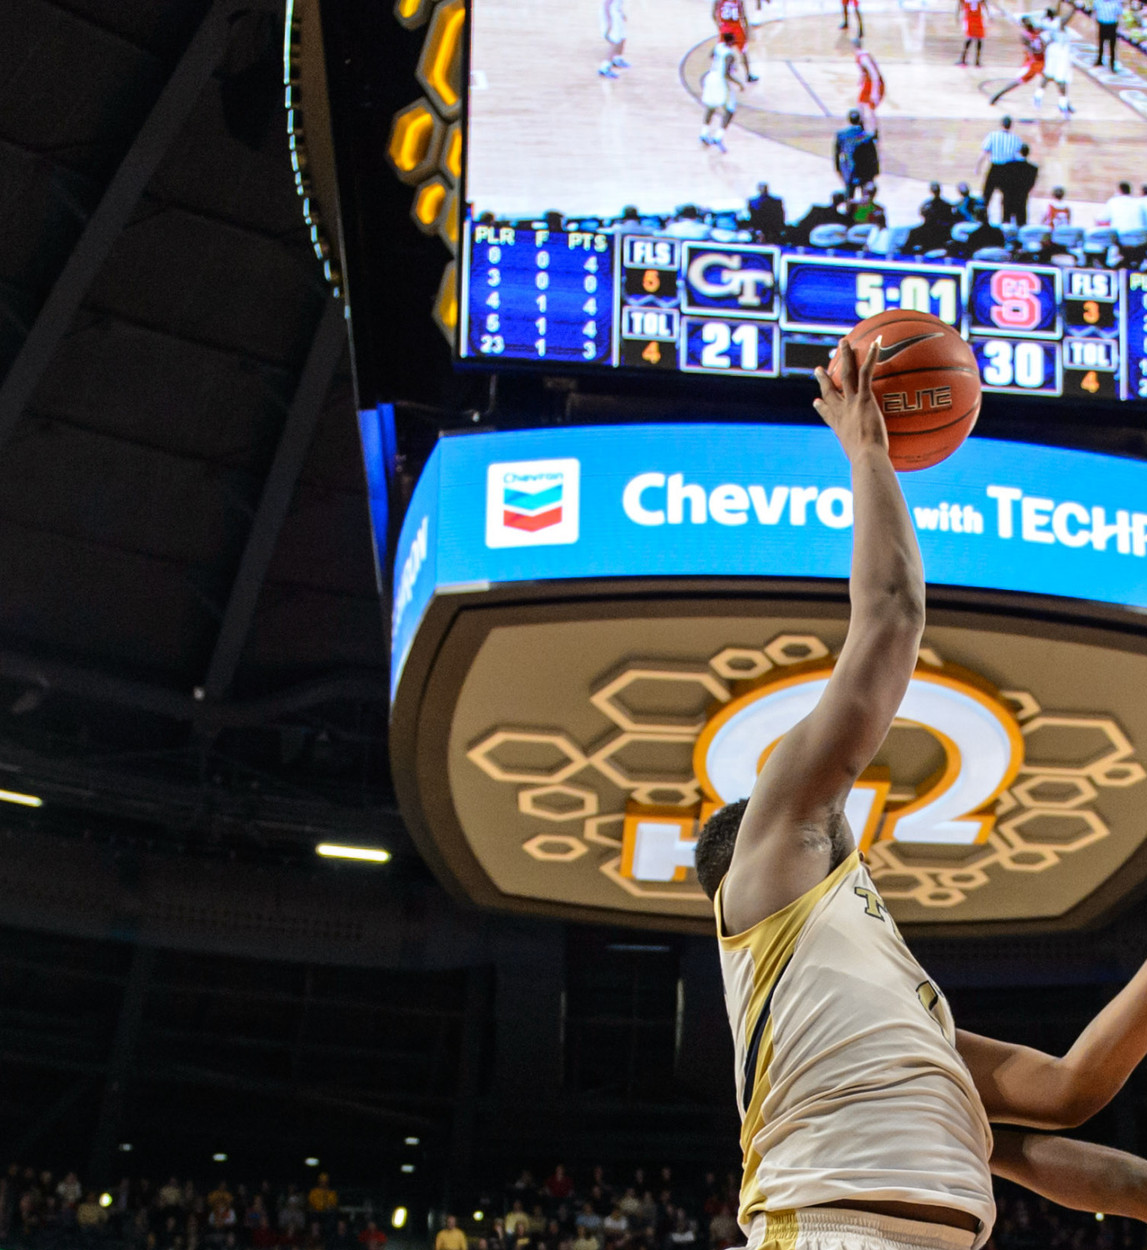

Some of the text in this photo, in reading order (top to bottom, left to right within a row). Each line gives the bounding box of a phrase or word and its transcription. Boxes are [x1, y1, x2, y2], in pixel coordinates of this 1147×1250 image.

[475, 225, 607, 252] PLR F PTS
[536, 251, 549, 269] 0
[583, 256, 599, 274] 4
[633, 241, 671, 266] FLS
[487, 268, 597, 294] 3 0 0
[688, 253, 774, 307] GT
[1071, 273, 1108, 298] FLS
[485, 291, 597, 316] 4 1 4
[855, 273, 957, 325] 5:01
[631, 312, 671, 337] TOL
[1083, 301, 1100, 324] 3
[535, 317, 547, 336] 1
[582, 320, 597, 339] 4
[480, 335, 596, 360] 23 1 3
[642, 341, 661, 365] 4
[702, 322, 759, 370] 21
[1070, 342, 1109, 366] TOL
[983, 341, 1045, 389] 30
[1080, 370, 1099, 393] 4
[882, 385, 952, 413] ELITE
[622, 473, 854, 528] Chevro
[914, 503, 984, 534] with
